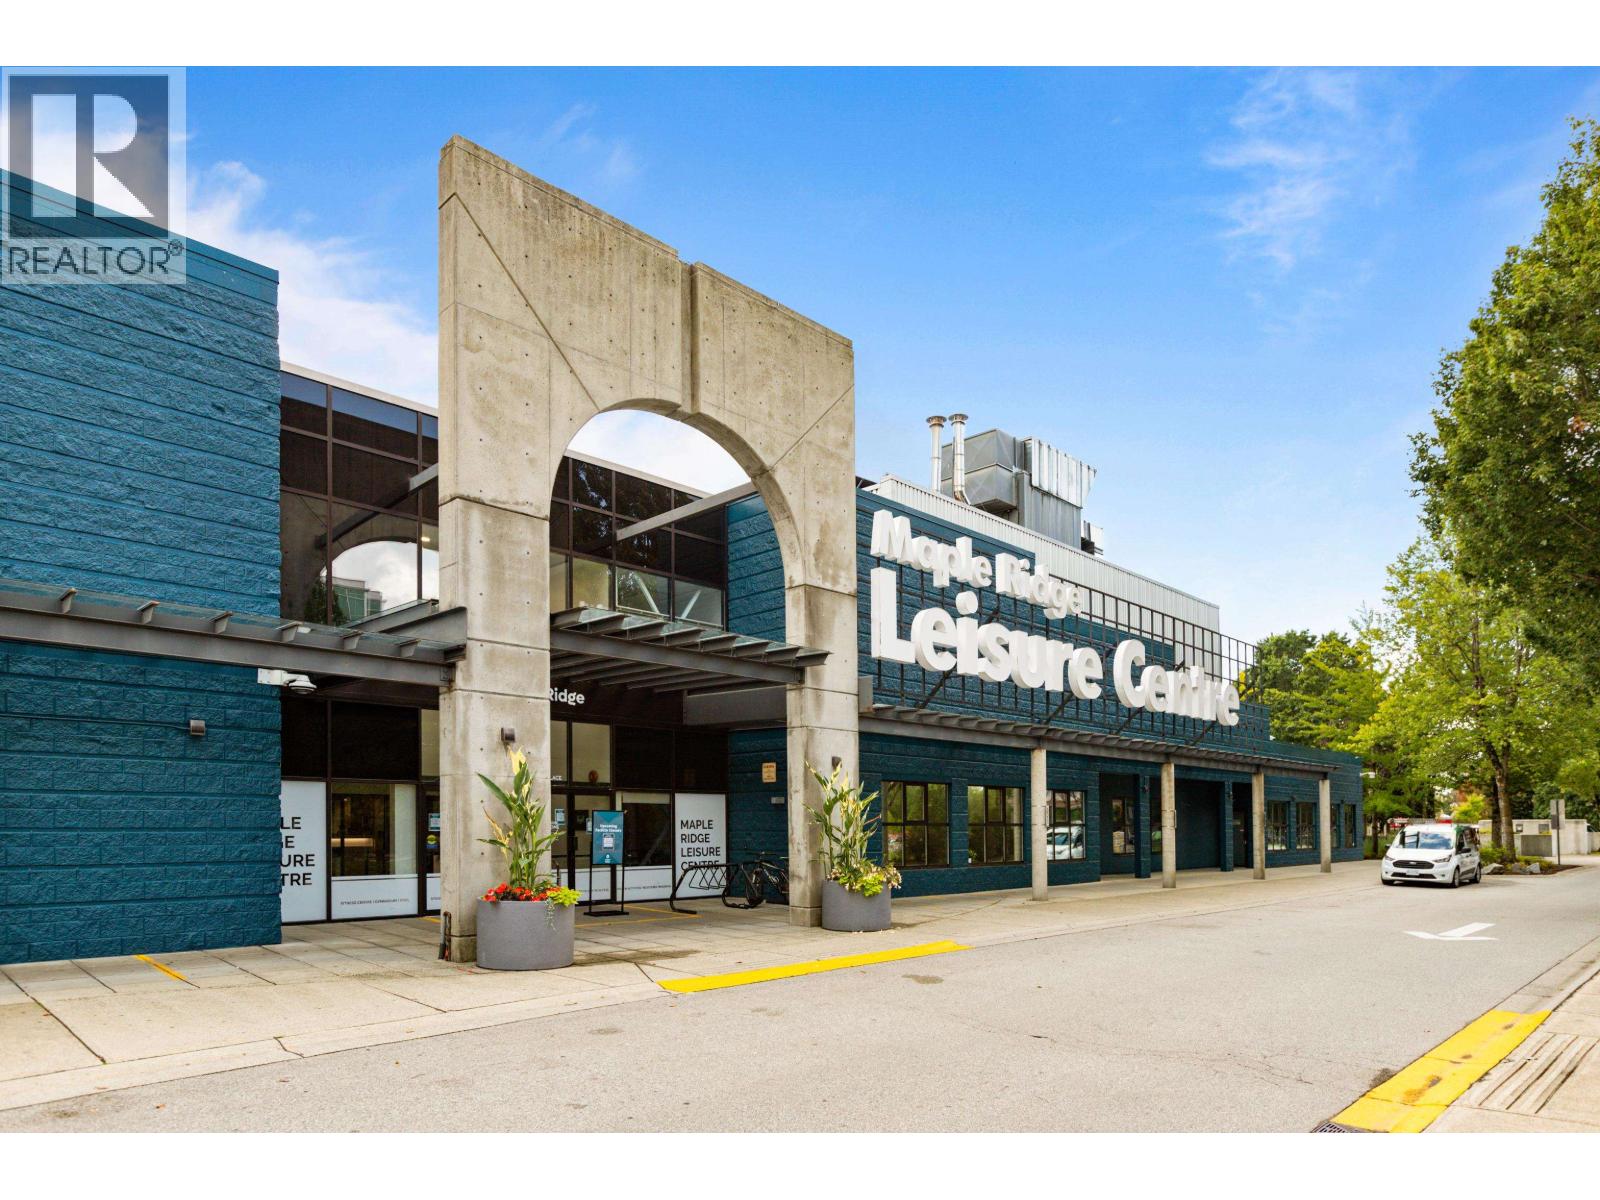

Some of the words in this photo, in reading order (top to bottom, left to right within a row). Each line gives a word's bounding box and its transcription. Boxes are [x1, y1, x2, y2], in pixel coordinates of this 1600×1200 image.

[871, 509, 992, 588] Maple
[995, 552, 1081, 620] Ridge
[871, 567, 1103, 699] Leisure
[1114, 639, 1240, 727] Centre
[549, 687, 585, 706] Ridge
[280, 816, 301, 830] LE
[680, 819, 714, 830] MAPLE
[680, 833, 712, 844] RIDGE
[680, 846, 721, 858] LEISURE
[280, 853, 316, 868] URE
[280, 872, 313, 887] TRE
